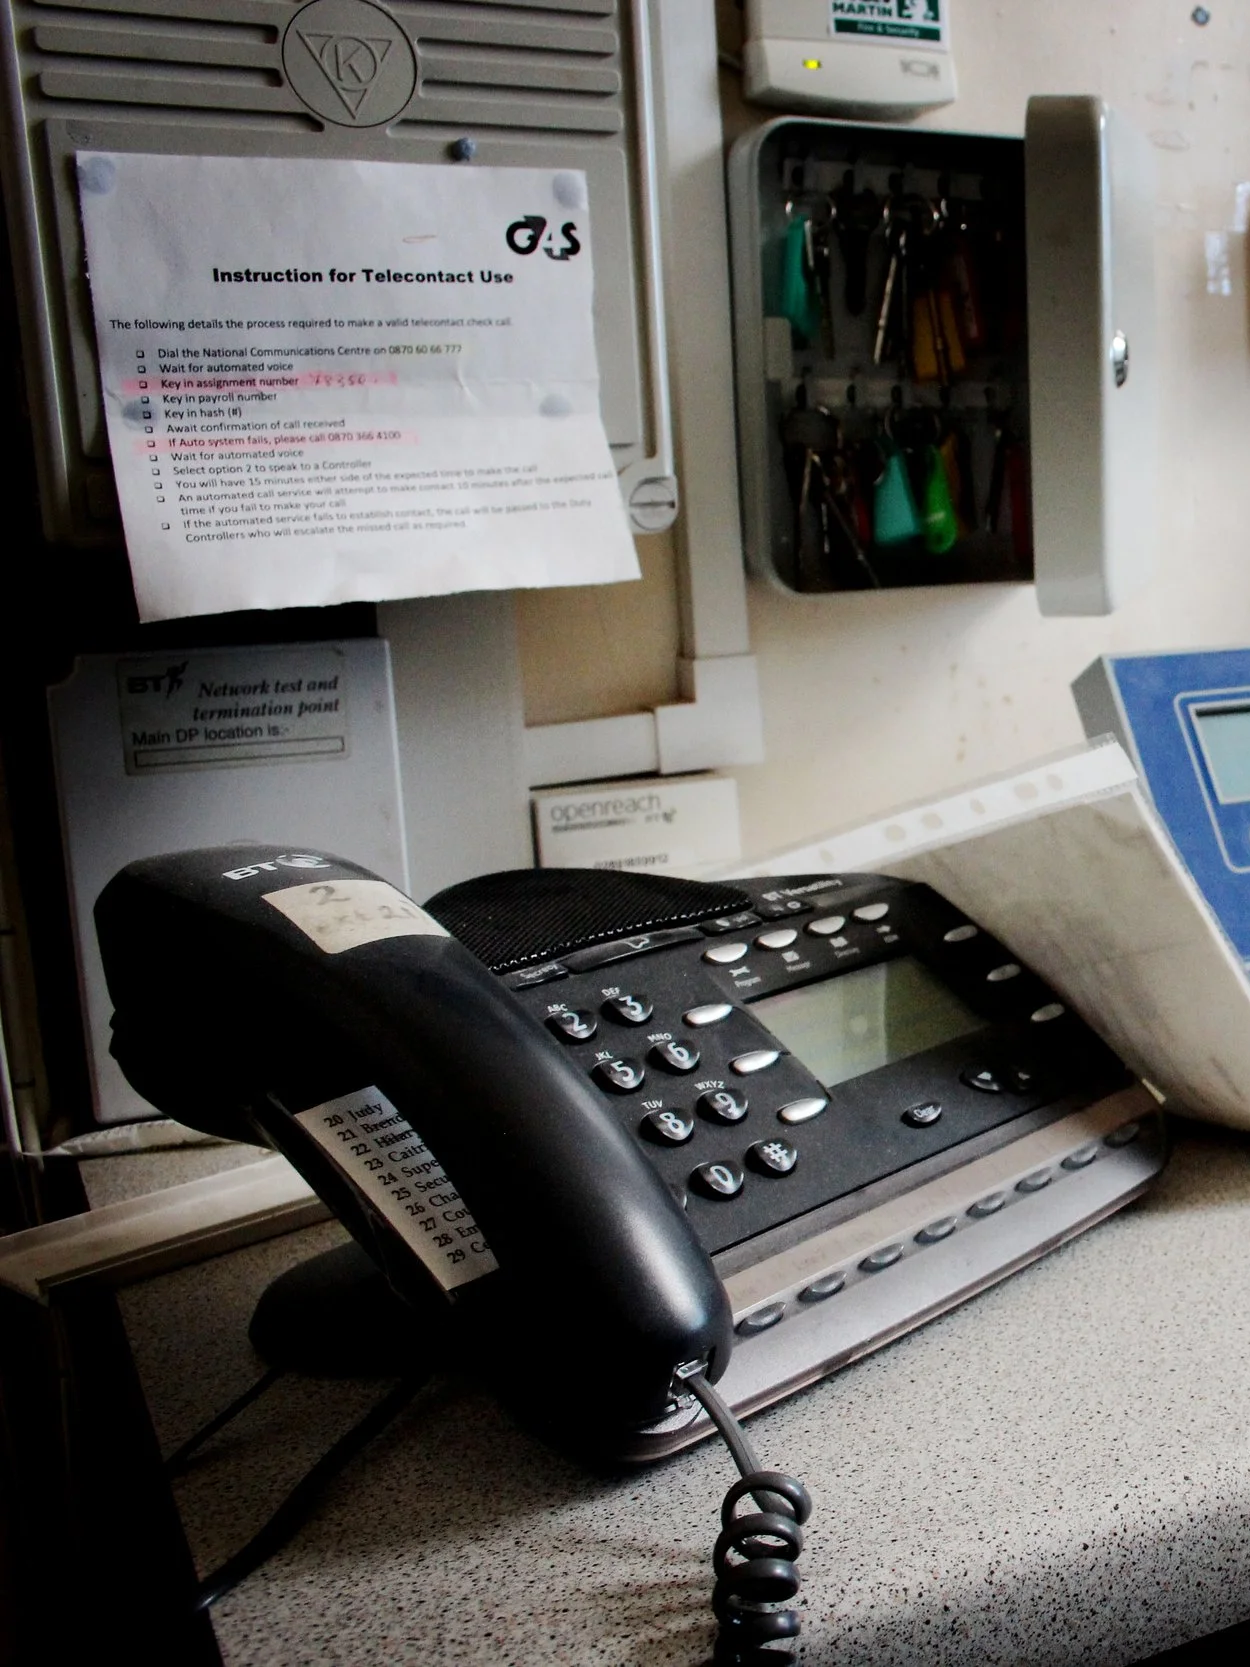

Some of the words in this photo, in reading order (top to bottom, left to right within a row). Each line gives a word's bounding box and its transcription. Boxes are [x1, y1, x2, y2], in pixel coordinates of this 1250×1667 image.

[832, 2, 893, 17] MARTIN
[886, 25, 920, 38] Security
[506, 215, 581, 260] G4S
[212, 268, 322, 282] Instruction
[329, 268, 356, 282] for
[362, 269, 474, 283] Telecontact
[480, 270, 514, 283] Use
[110, 320, 131, 329] The
[134, 319, 185, 331] following
[188, 319, 223, 329] details
[226, 319, 244, 329] the
[246, 321, 285, 332] process
[288, 319, 331, 331] required
[334, 320, 344, 328] to
[348, 318, 374, 328] make
[378, 320, 383, 328] a
[386, 318, 408, 328] valid
[412, 318, 464, 327] telecontact
[467, 318, 492, 326] check
[158, 349, 179, 358] Dial
[182, 349, 200, 358] the
[202, 348, 247, 358] National
[250, 346, 334, 356] Communications
[338, 346, 370, 356] Centre
[389, 346, 414, 354] 0870
[416, 346, 428, 354] 60
[430, 345, 442, 354] 66
[160, 364, 184, 373] Wait
[188, 364, 203, 372] for
[207, 362, 264, 372] automated
[267, 362, 294, 371] voice
[161, 380, 180, 390] Key
[184, 379, 193, 388] in
[196, 378, 256, 390] assignment
[259, 378, 299, 386] number
[163, 394, 182, 404] Key
[186, 394, 195, 402] in
[200, 392, 234, 403] payroll
[238, 392, 276, 401] number
[165, 410, 184, 420] Key
[187, 409, 198, 418] in
[200, 408, 225, 417] hash
[228, 408, 242, 418] (#)
[167, 424, 197, 433] Await
[200, 422, 267, 432] confirmation
[270, 421, 280, 430] of
[284, 420, 300, 430] call
[303, 419, 345, 429] received
[169, 438, 176, 447] If
[180, 438, 205, 447] Auto
[208, 438, 244, 448] system
[248, 436, 271, 446] fails,
[274, 434, 306, 444] please
[309, 433, 325, 442] call
[328, 432, 353, 441] 0870
[356, 432, 374, 440] 366
[376, 431, 401, 440] 4100
[171, 452, 197, 461] Wait
[200, 452, 214, 460] for
[218, 450, 275, 460] automated
[278, 450, 304, 458] voice
[174, 466, 205, 475] Select
[209, 464, 243, 475] option
[246, 464, 252, 473] 2
[255, 464, 266, 472] to
[269, 463, 296, 474] speak
[301, 462, 311, 471] to
[322, 460, 372, 470] Controller
[176, 480, 196, 489] You
[200, 479, 217, 488] will
[220, 478, 245, 487] have
[249, 478, 260, 486] 15
[264, 476, 304, 485] minutes
[179, 494, 192, 502] An
[196, 492, 254, 502] automated
[257, 491, 274, 499] call
[278, 489, 311, 497] service
[181, 506, 205, 515] time
[209, 505, 216, 514] if
[219, 506, 237, 515] you
[240, 504, 257, 512] fail
[260, 503, 270, 511] to
[274, 502, 300, 510] make
[194, 520, 211, 528] the
[215, 517, 273, 527] automated
[275, 516, 310, 524] service
[186, 532, 245, 543] Controllers
[248, 530, 270, 538] who
[274, 529, 291, 537] will
[127, 674, 166, 694] BT
[198, 680, 271, 698] Network
[274, 678, 303, 694] test
[307, 676, 338, 691] and
[193, 700, 293, 721] termination
[298, 699, 339, 718] point
[132, 731, 170, 747] Main
[176, 728, 199, 743] DP
[205, 725, 262, 741] location
[551, 794, 661, 824] openreach
[222, 862, 278, 880] BT
[309, 886, 351, 905] 2
[601, 986, 621, 997] DEF
[547, 1003, 568, 1013] ABC
[618, 995, 642, 1016] 3
[562, 1012, 587, 1032] 2
[647, 1033, 672, 1042] MNO
[595, 1051, 613, 1060] JKL
[667, 1042, 690, 1062] 6
[610, 1061, 635, 1082] 5
[694, 1080, 725, 1090] WXYZ
[641, 1100, 663, 1110] TUV
[715, 1092, 737, 1115] 9
[324, 1114, 344, 1128] 20
[348, 1102, 383, 1122] Judy
[659, 1112, 685, 1134] 8
[337, 1129, 357, 1142] 21
[351, 1143, 371, 1156] 22
[763, 1142, 788, 1162] #
[364, 1158, 384, 1171] 23
[378, 1172, 398, 1186] 24
[401, 1160, 440, 1179] Supe
[710, 1165, 734, 1188] 0
[391, 1188, 411, 1201] 25
[405, 1203, 425, 1216] 26
[429, 1192, 460, 1208] Cha
[419, 1217, 437, 1232] 27
[433, 1234, 453, 1248] 28
[447, 1250, 466, 1264] 29
